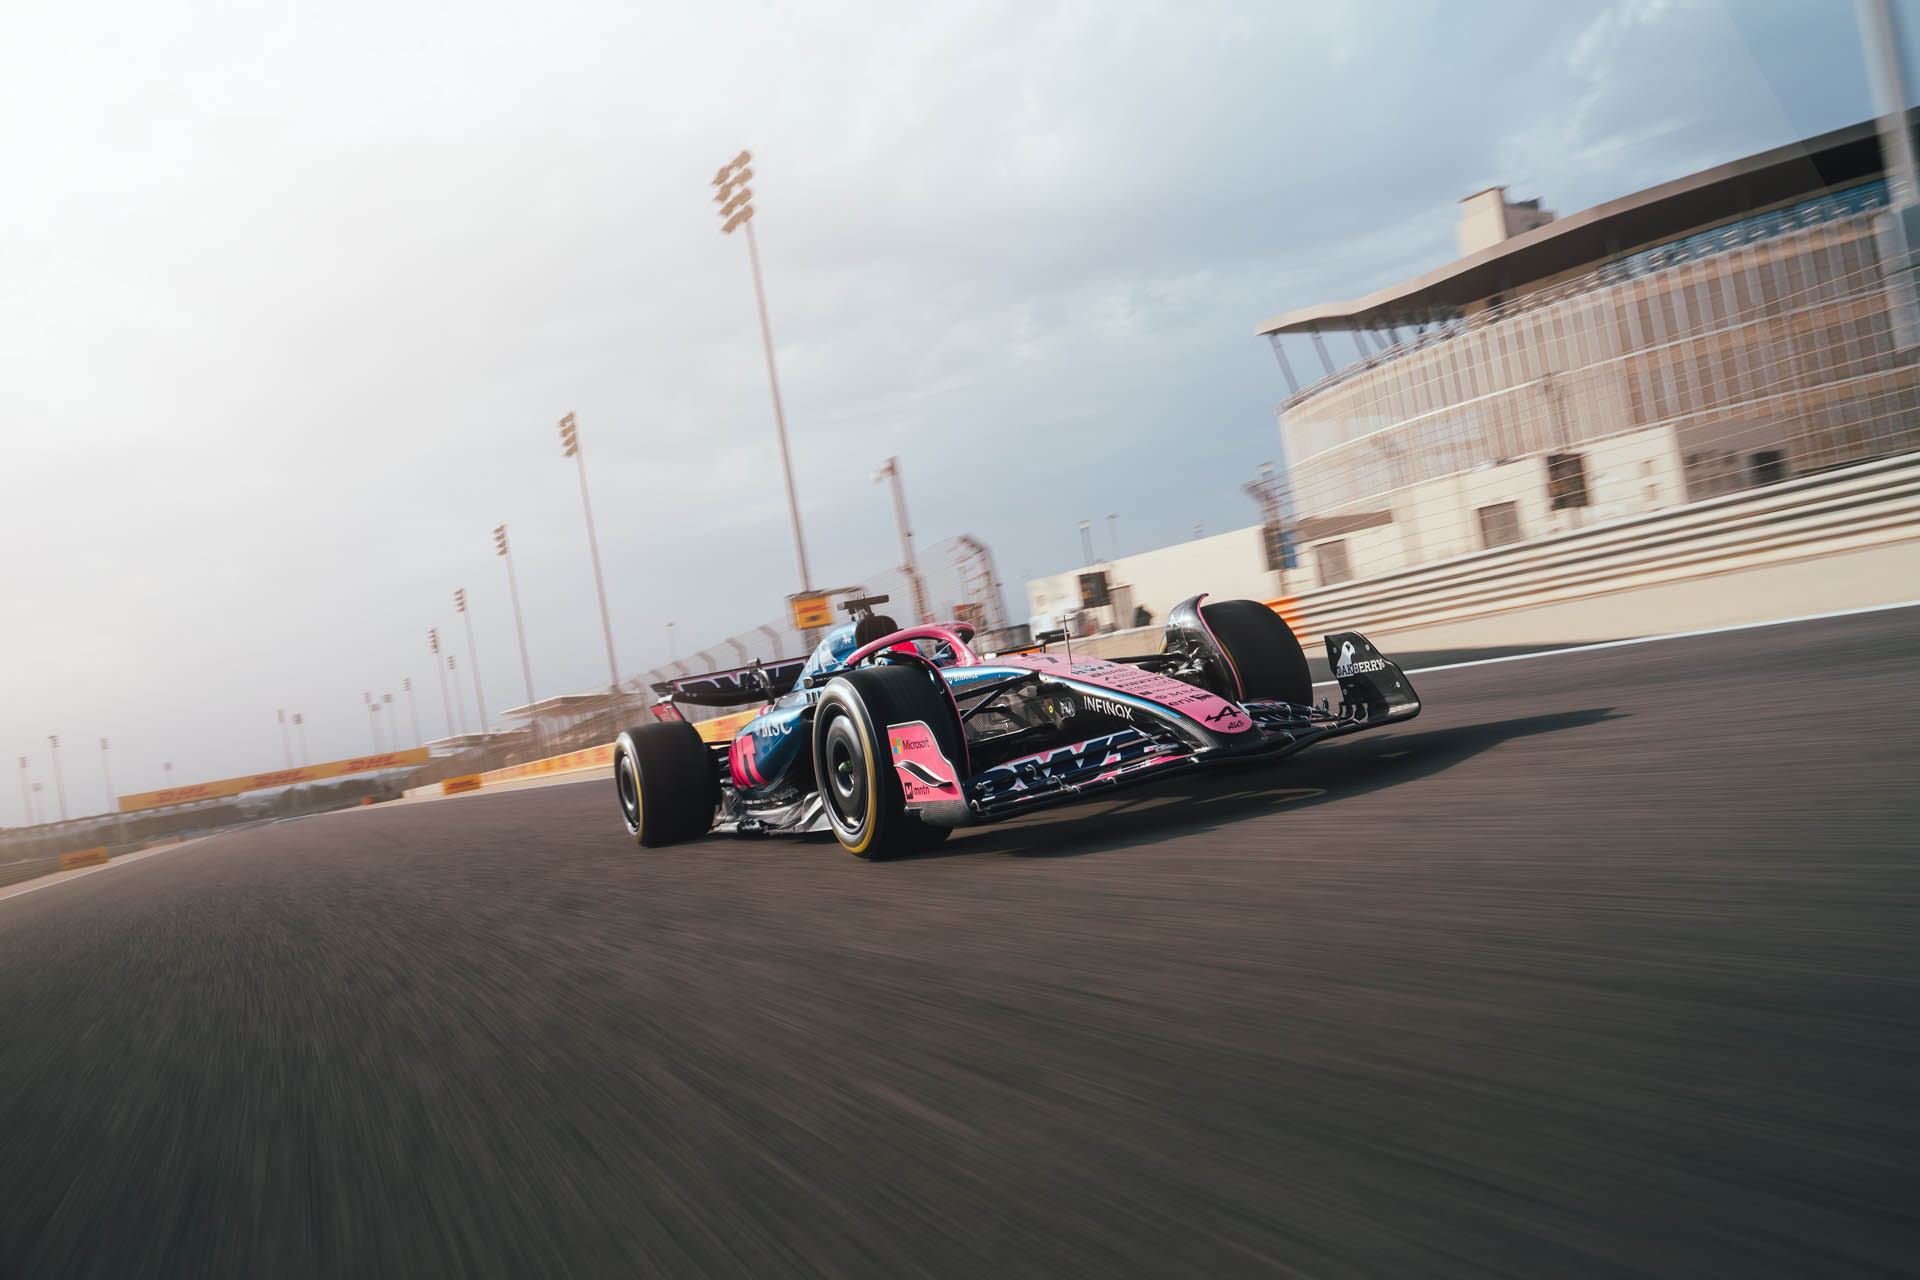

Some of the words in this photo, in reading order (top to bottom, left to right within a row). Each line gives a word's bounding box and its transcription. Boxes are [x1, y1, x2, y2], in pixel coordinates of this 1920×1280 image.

[1083, 696, 1135, 721] INFINOX
[761, 720, 792, 737] MSC
[902, 738, 930, 750] Microsoft
